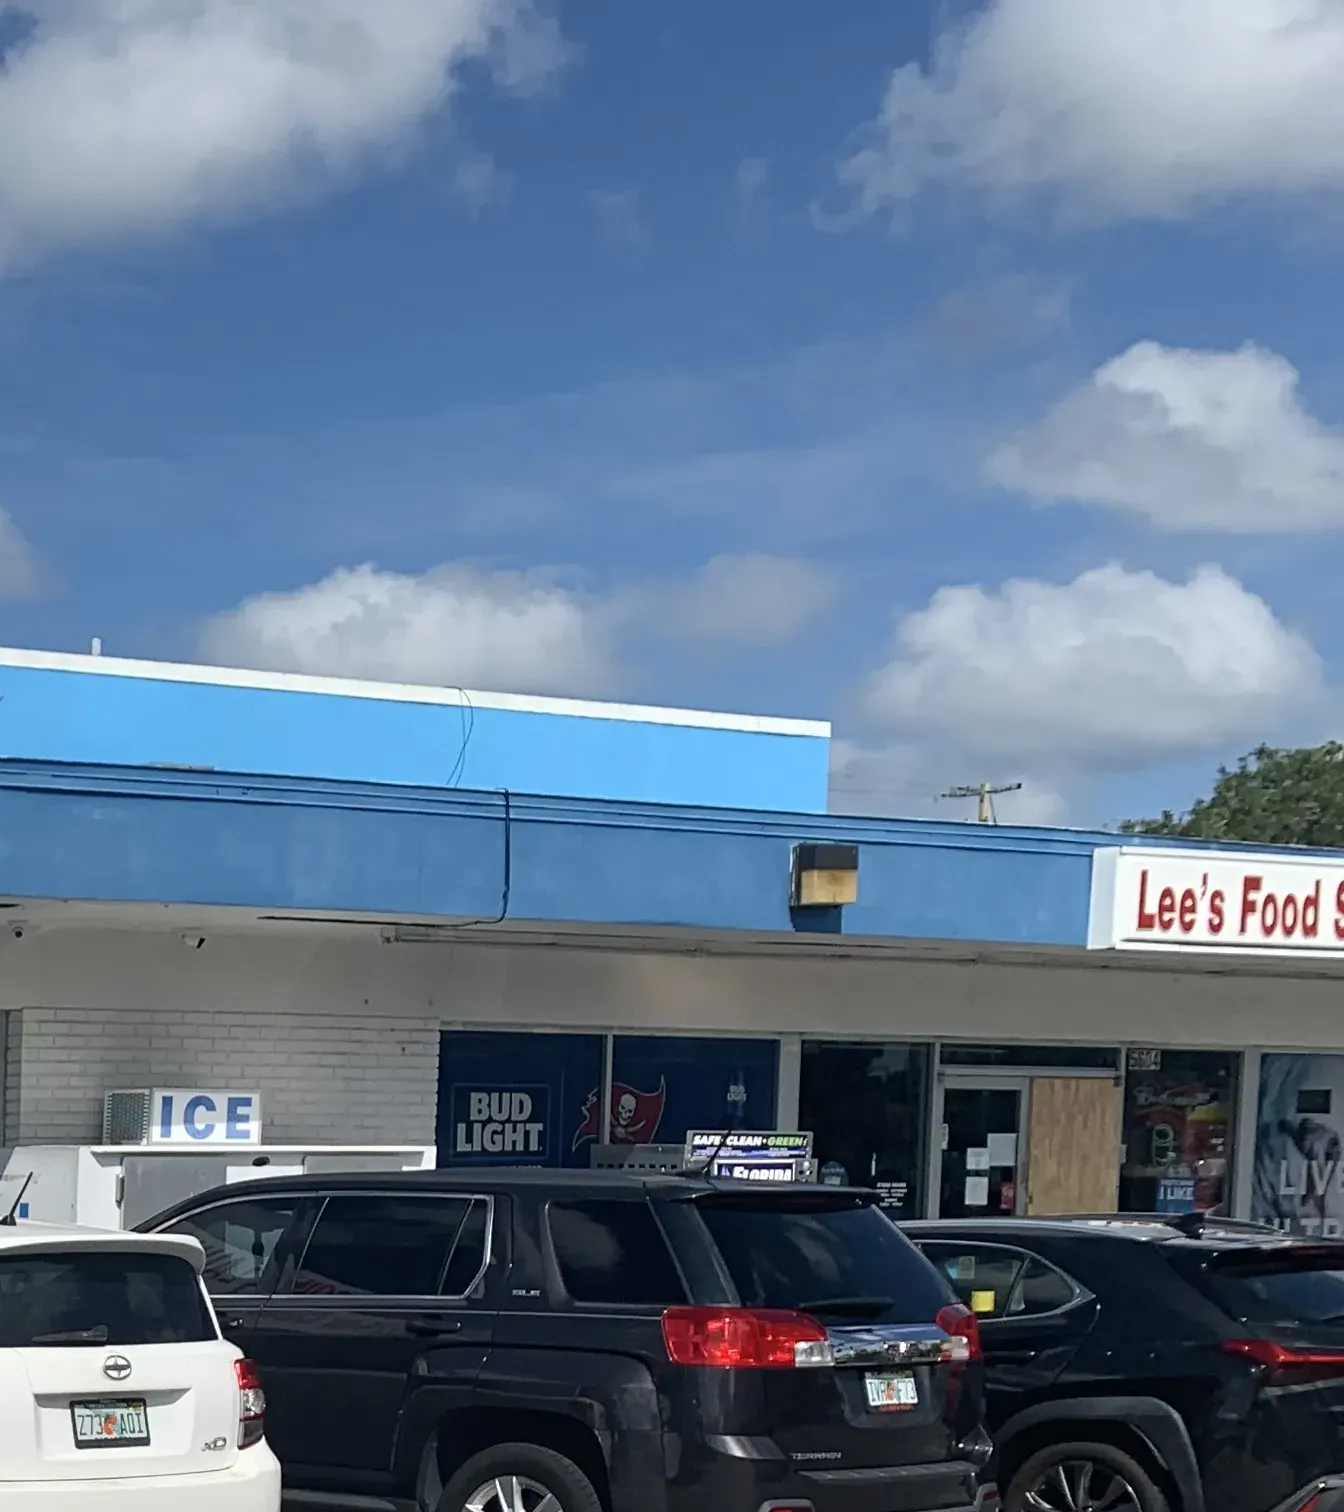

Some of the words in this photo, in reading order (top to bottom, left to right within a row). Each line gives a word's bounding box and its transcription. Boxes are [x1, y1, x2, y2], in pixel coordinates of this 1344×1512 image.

[1137, 869, 1226, 935] Lee's
[1239, 875, 1322, 938] Food
[160, 1095, 253, 1140] ICE
[469, 1091, 533, 1121] BUD
[456, 1122, 544, 1152] LIGHT
